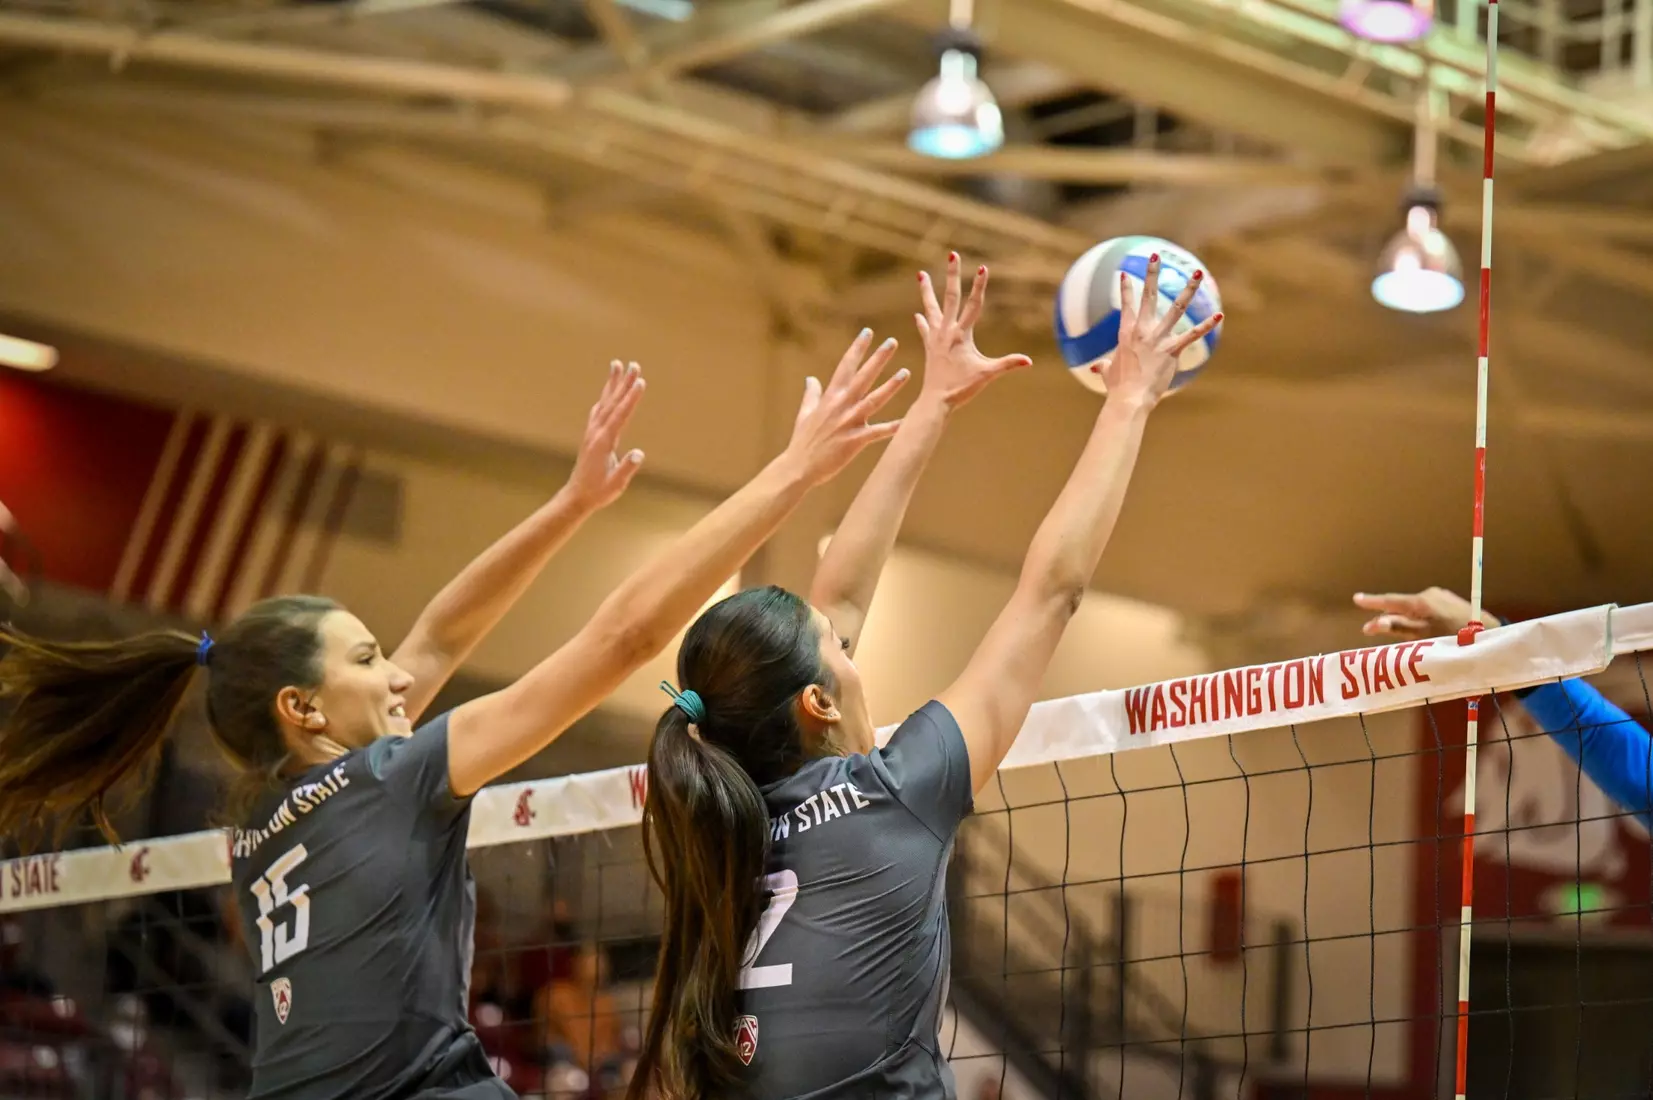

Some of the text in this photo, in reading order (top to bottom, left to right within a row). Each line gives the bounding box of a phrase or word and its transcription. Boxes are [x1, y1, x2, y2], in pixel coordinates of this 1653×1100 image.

[1125, 641, 1435, 736] WASHINGTON STATE
[292, 761, 350, 814] STATE
[794, 782, 871, 833] STATE
[10, 853, 61, 898] STATE
[250, 843, 310, 973] 15
[735, 868, 799, 990] 2
